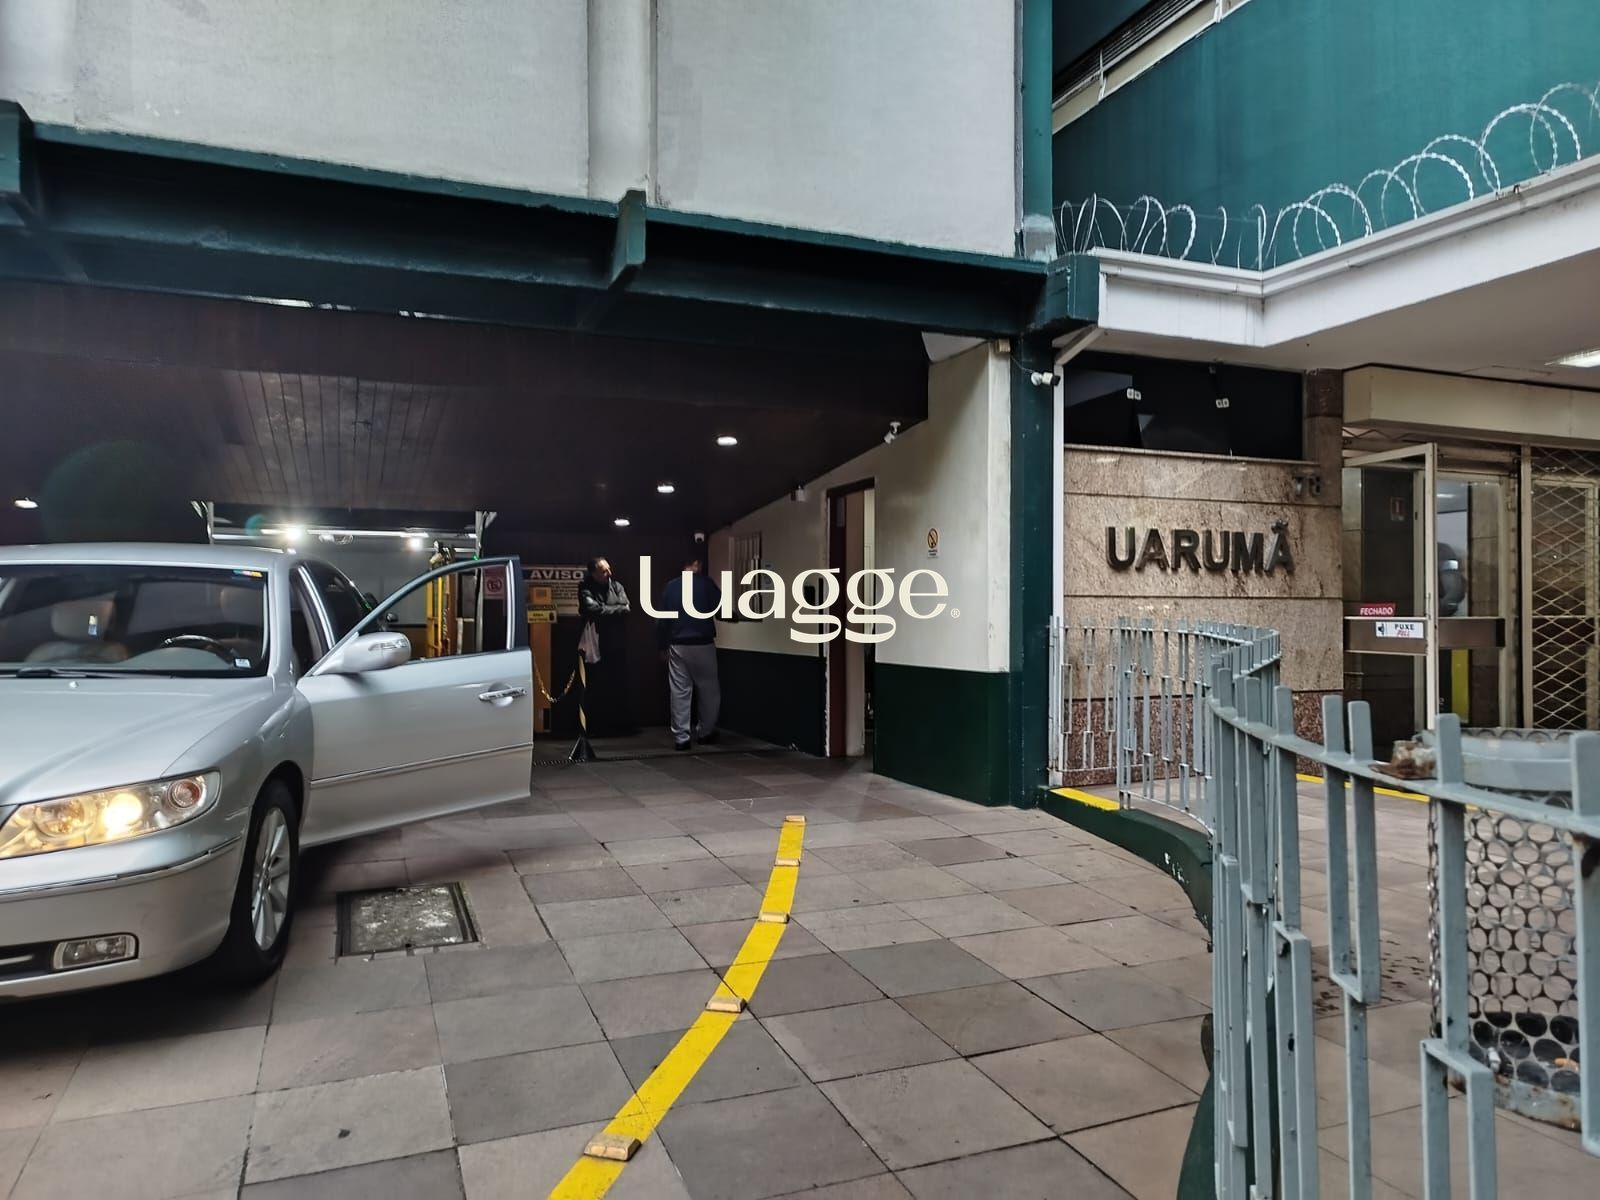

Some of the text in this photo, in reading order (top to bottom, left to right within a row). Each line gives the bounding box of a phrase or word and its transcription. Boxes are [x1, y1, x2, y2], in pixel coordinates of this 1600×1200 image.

[1105, 520, 1296, 573] UARUMÃ
[530, 570, 584, 579] AVISO
[1360, 607, 1393, 616] FECHADO
